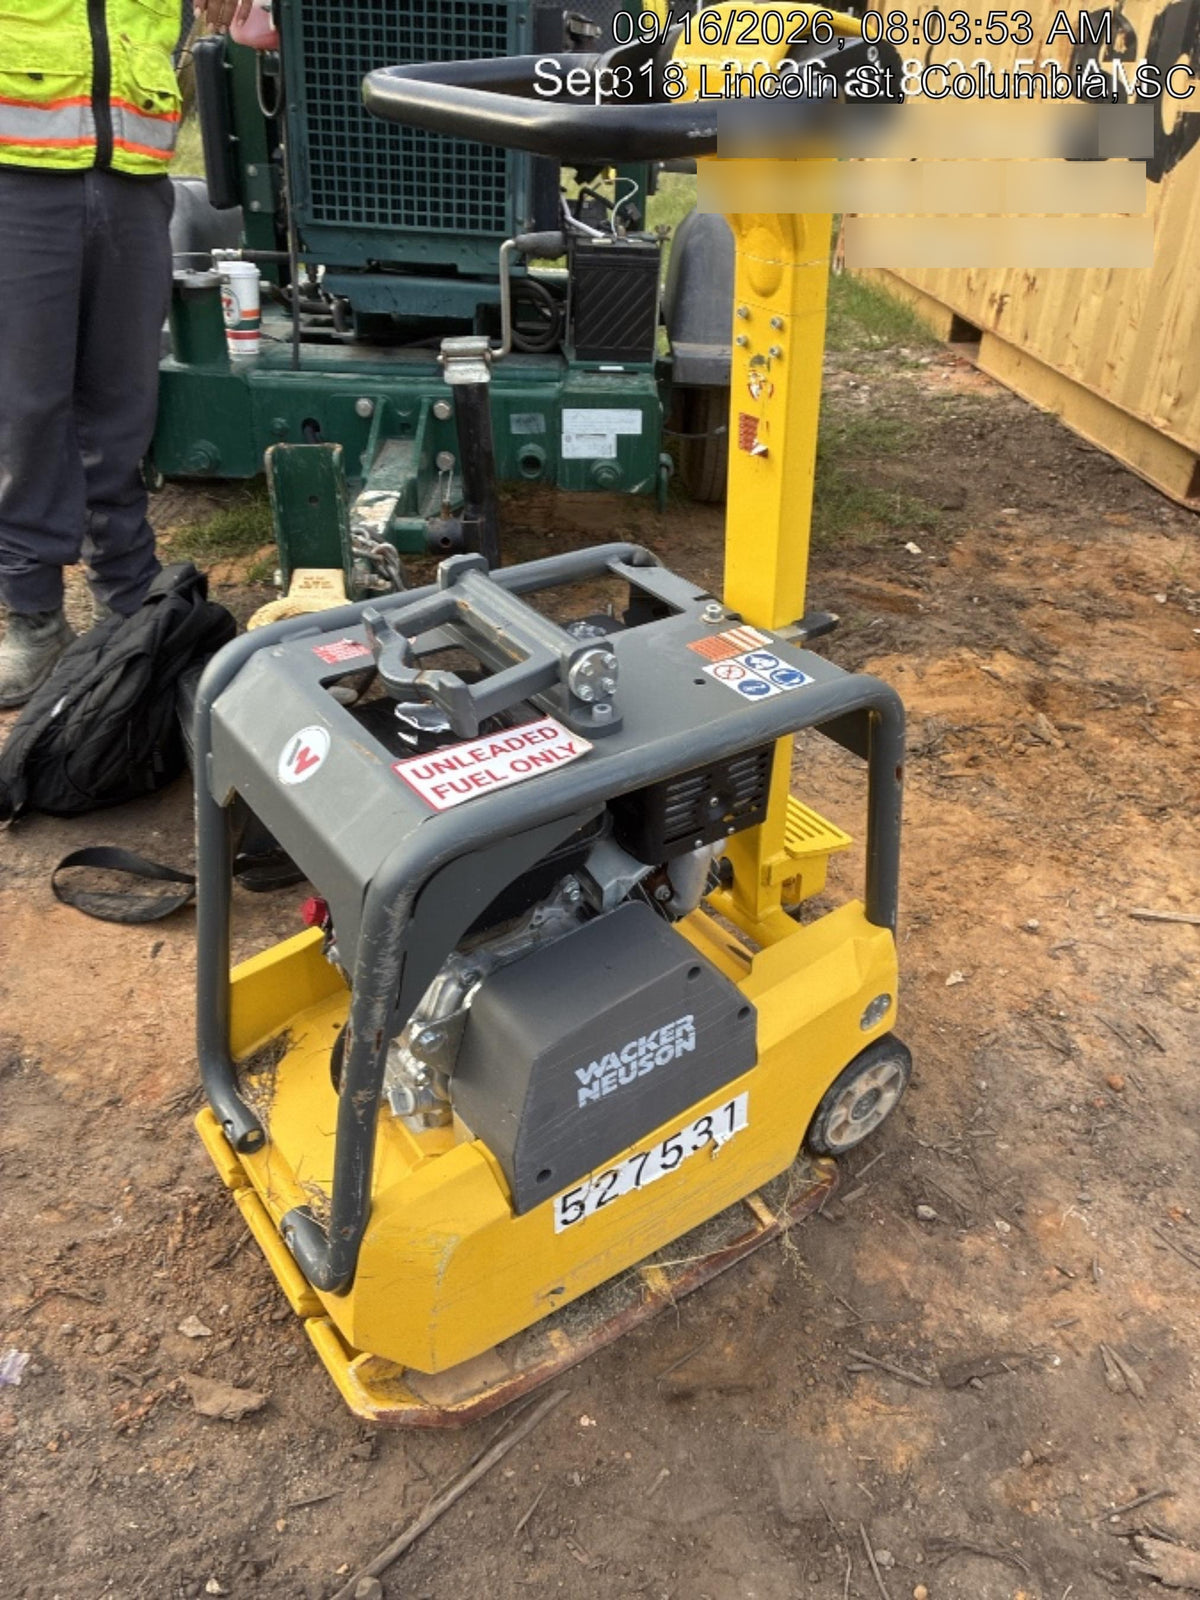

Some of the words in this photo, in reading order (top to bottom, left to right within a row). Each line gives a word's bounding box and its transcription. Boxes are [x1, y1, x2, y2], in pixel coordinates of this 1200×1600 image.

[410, 726, 559, 780] UNLEADED
[430, 769, 508, 800] FUEL
[510, 741, 578, 773] ONLY
[574, 1014, 695, 1085] WACKER
[577, 1029, 696, 1108] NEUSON
[560, 1100, 736, 1225] 527531
